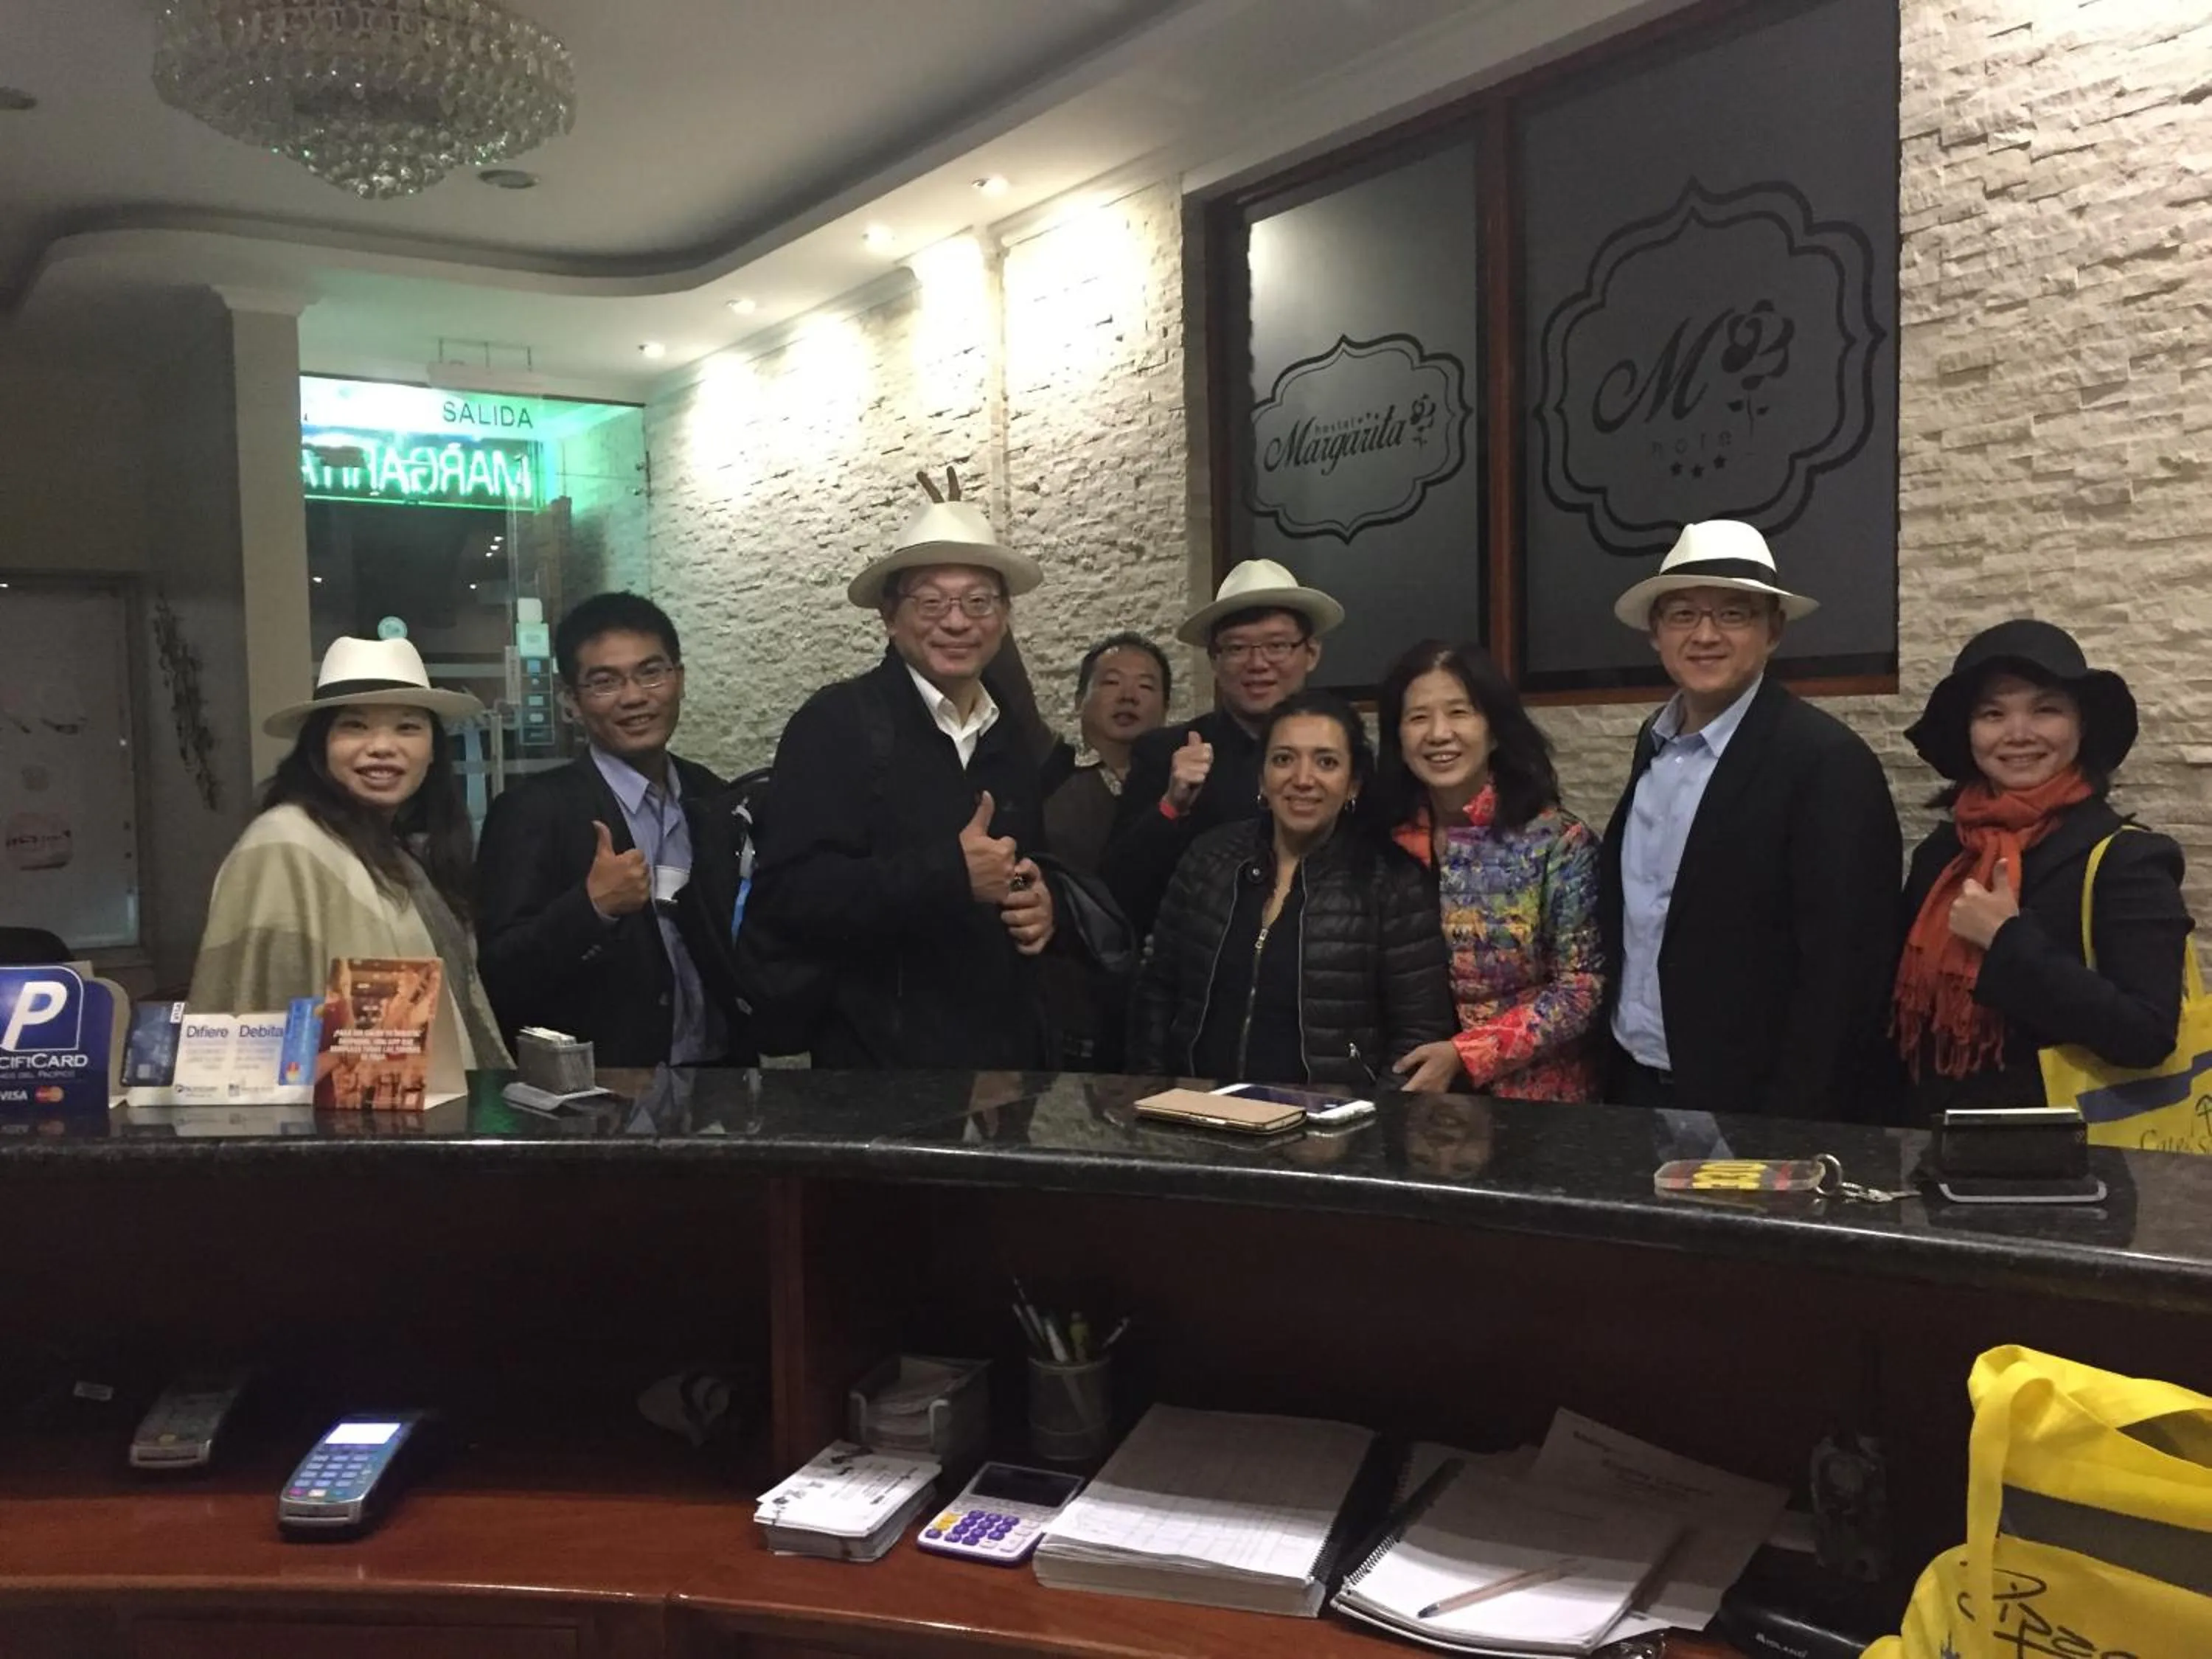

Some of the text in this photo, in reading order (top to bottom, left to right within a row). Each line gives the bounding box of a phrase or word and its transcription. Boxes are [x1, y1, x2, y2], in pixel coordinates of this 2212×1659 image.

[442, 400, 533, 428] SALIDA
[1263, 405, 1407, 476] Margarita
[0, 1090, 28, 1101] VISA
